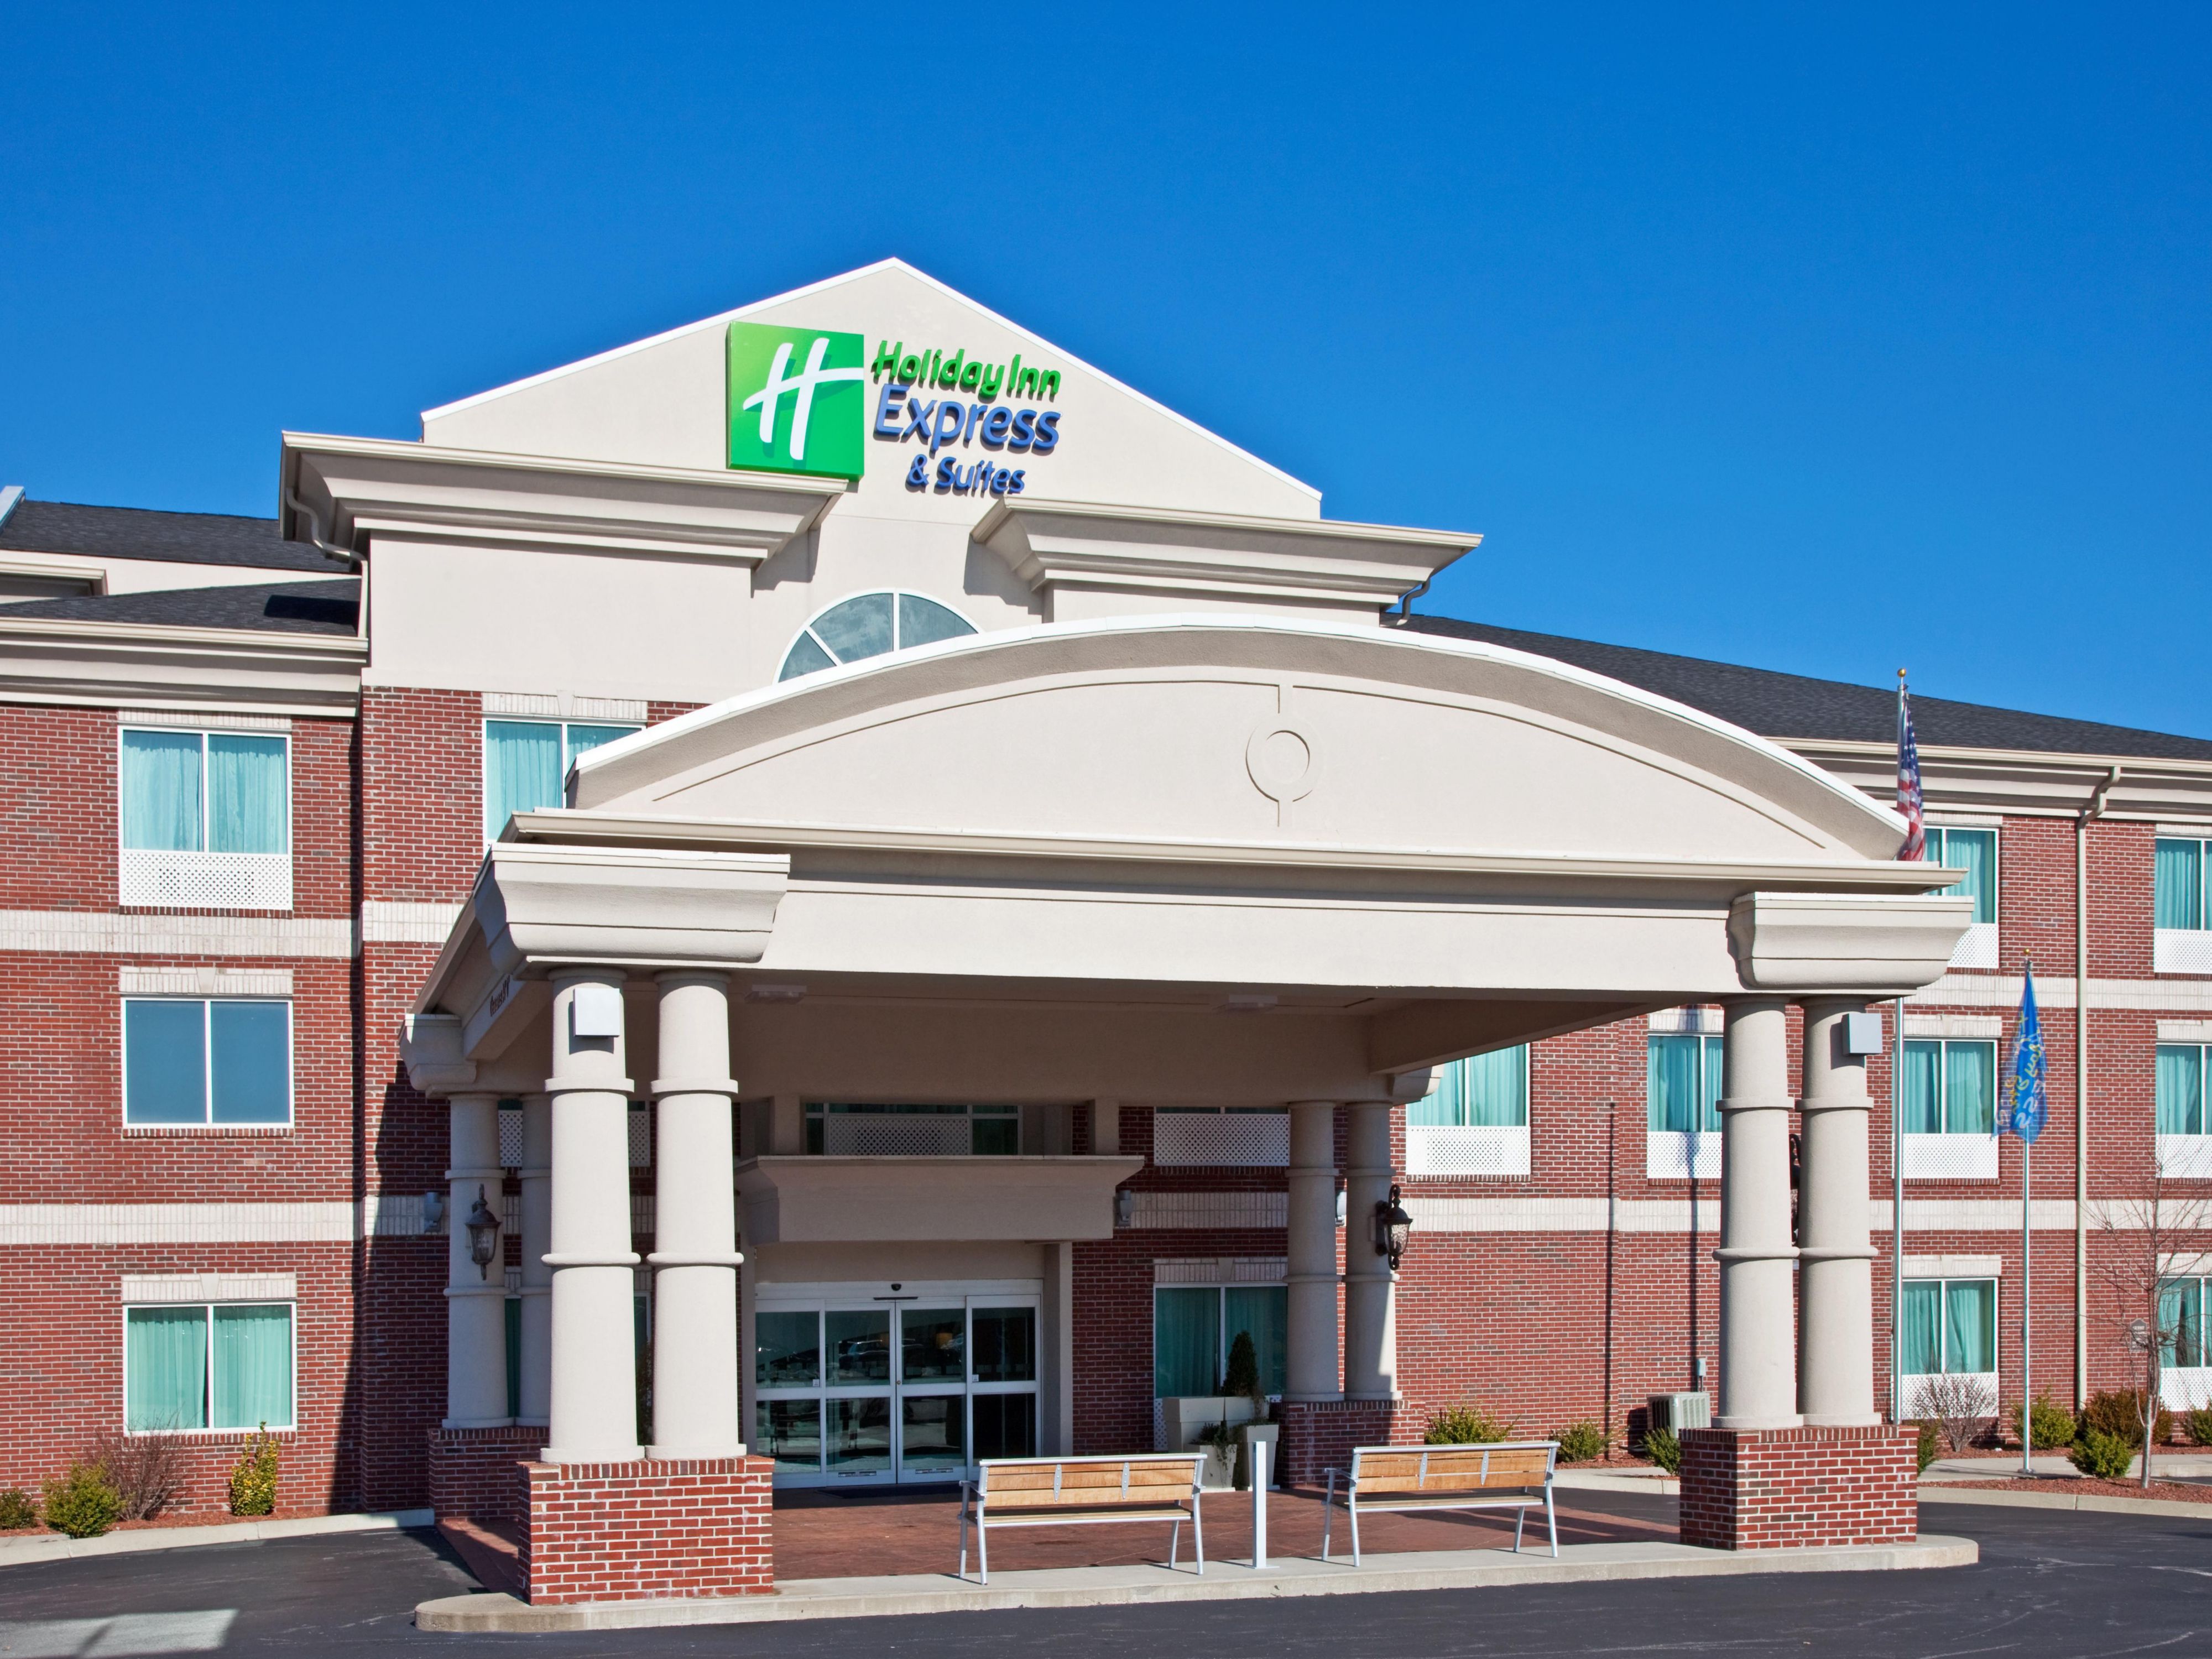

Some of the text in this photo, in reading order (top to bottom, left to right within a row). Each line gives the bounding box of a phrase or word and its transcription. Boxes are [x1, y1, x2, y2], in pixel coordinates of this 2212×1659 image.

[872, 340, 1061, 398] Holiday Inn
[875, 384, 1061, 453] Express
[907, 454, 1026, 494] & Suites
